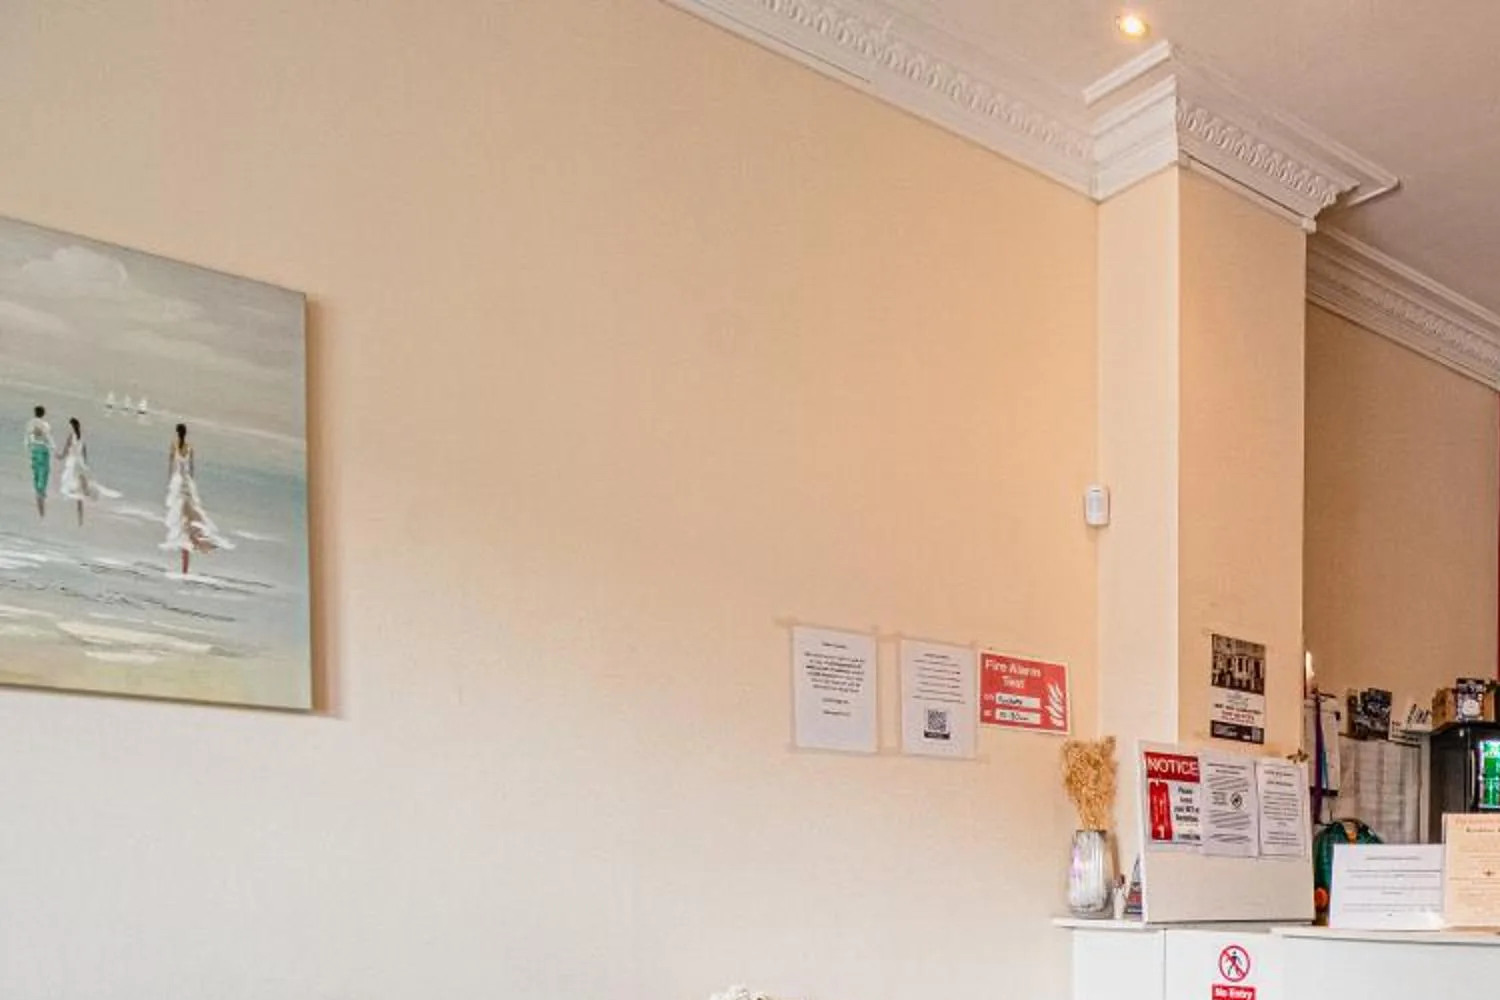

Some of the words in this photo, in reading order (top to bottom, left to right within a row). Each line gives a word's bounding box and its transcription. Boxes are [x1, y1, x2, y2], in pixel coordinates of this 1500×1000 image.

[985, 658, 1008, 673] Fire
[1008, 662, 1042, 678] Alarm
[1001, 674, 1025, 689] Test
[1147, 757, 1198, 776] NOTICE
